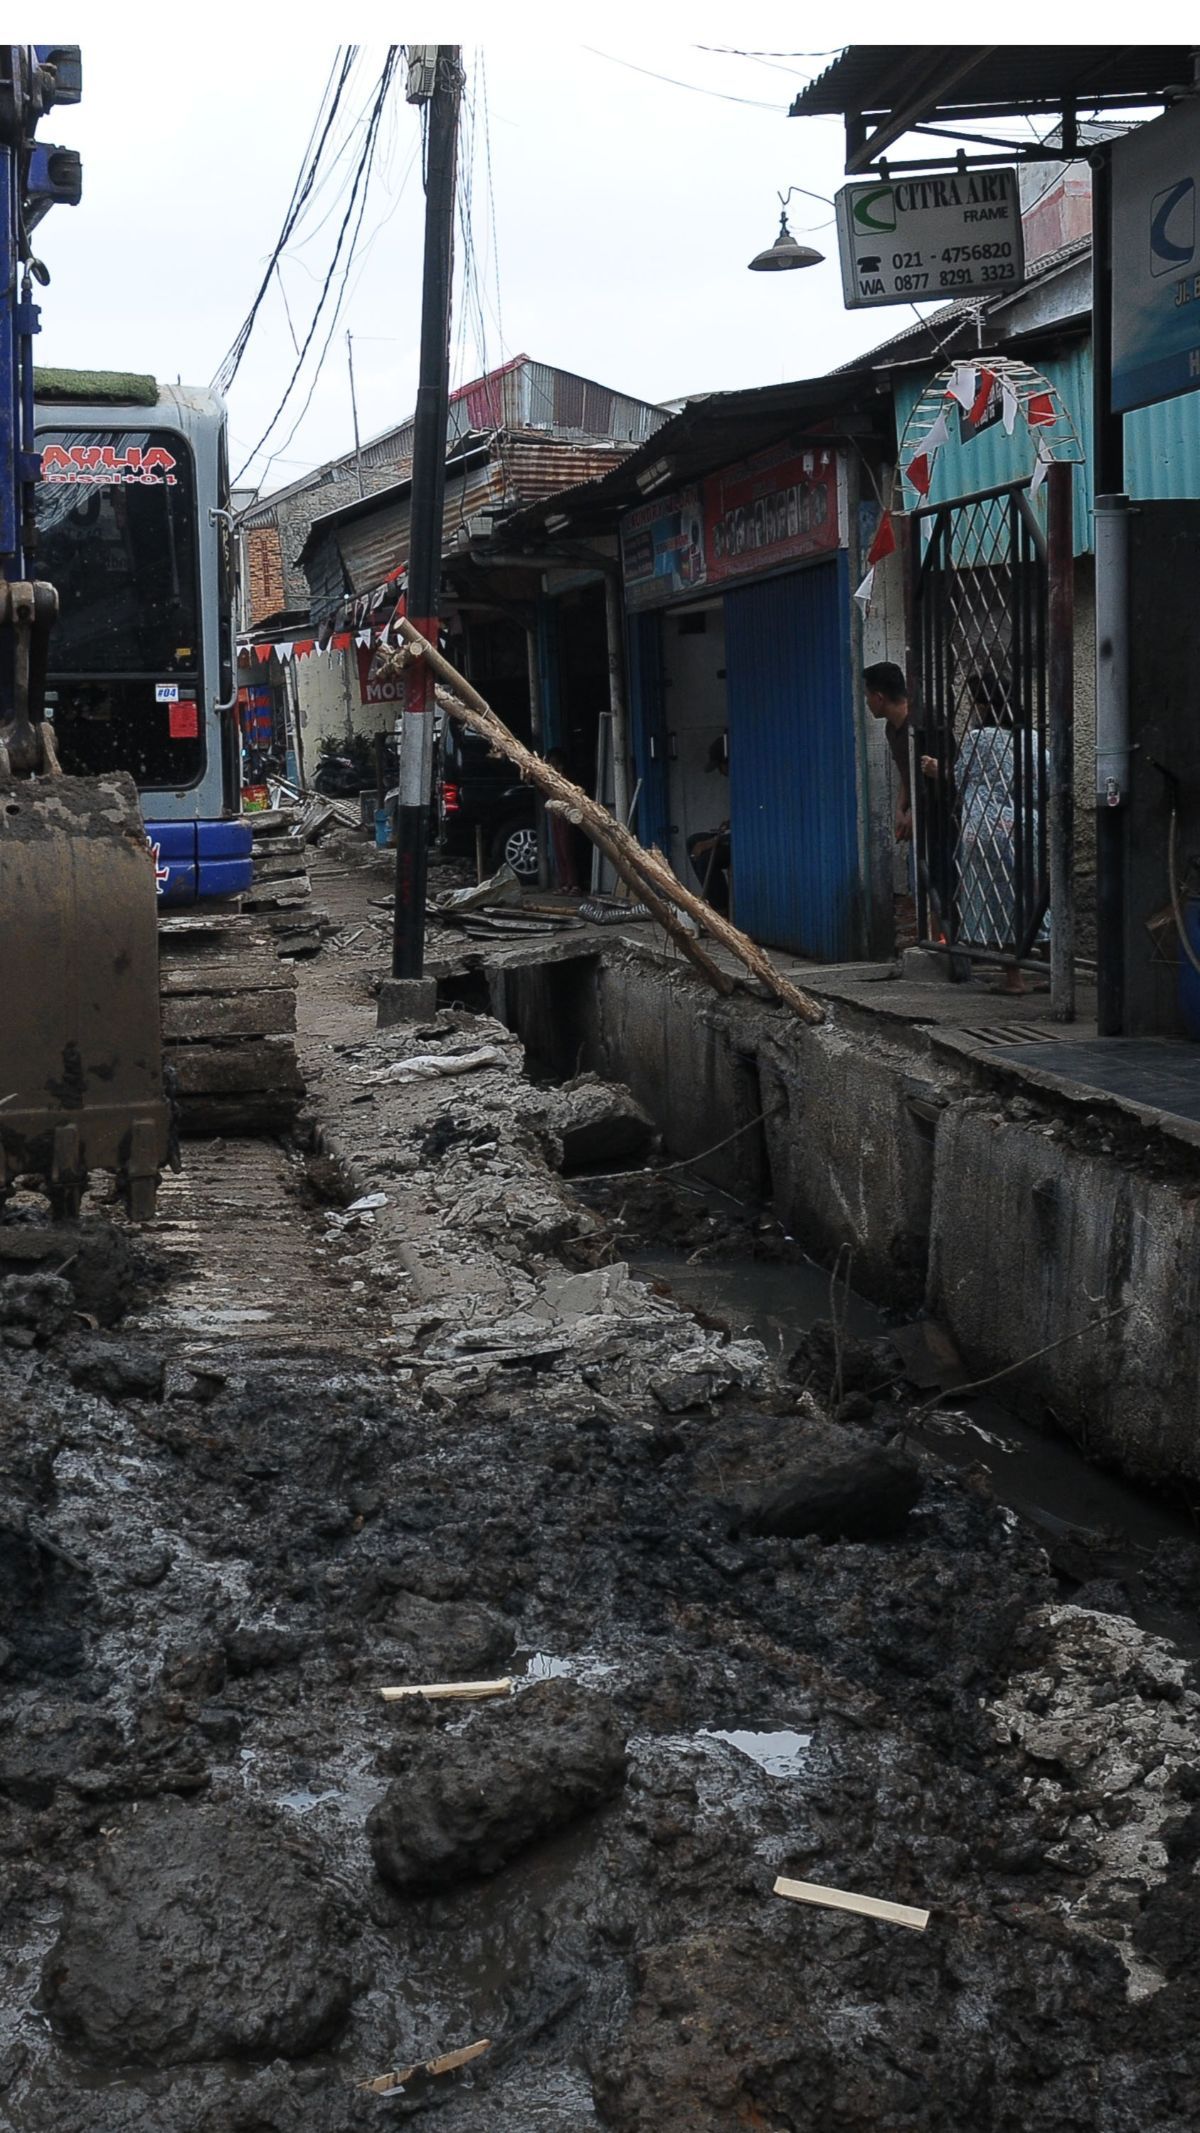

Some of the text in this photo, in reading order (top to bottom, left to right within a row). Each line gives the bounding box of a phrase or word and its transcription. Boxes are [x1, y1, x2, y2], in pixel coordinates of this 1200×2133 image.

[895, 174, 1011, 212] CITRA ART
[964, 207, 1009, 223] FRAME
[892, 252, 923, 270] 021
[941, 242, 1012, 263] 4756820
[860, 264, 1015, 296] WA 0877 8291 3323
[41, 445, 176, 474] AULIA
[158, 688, 177, 698] #04
